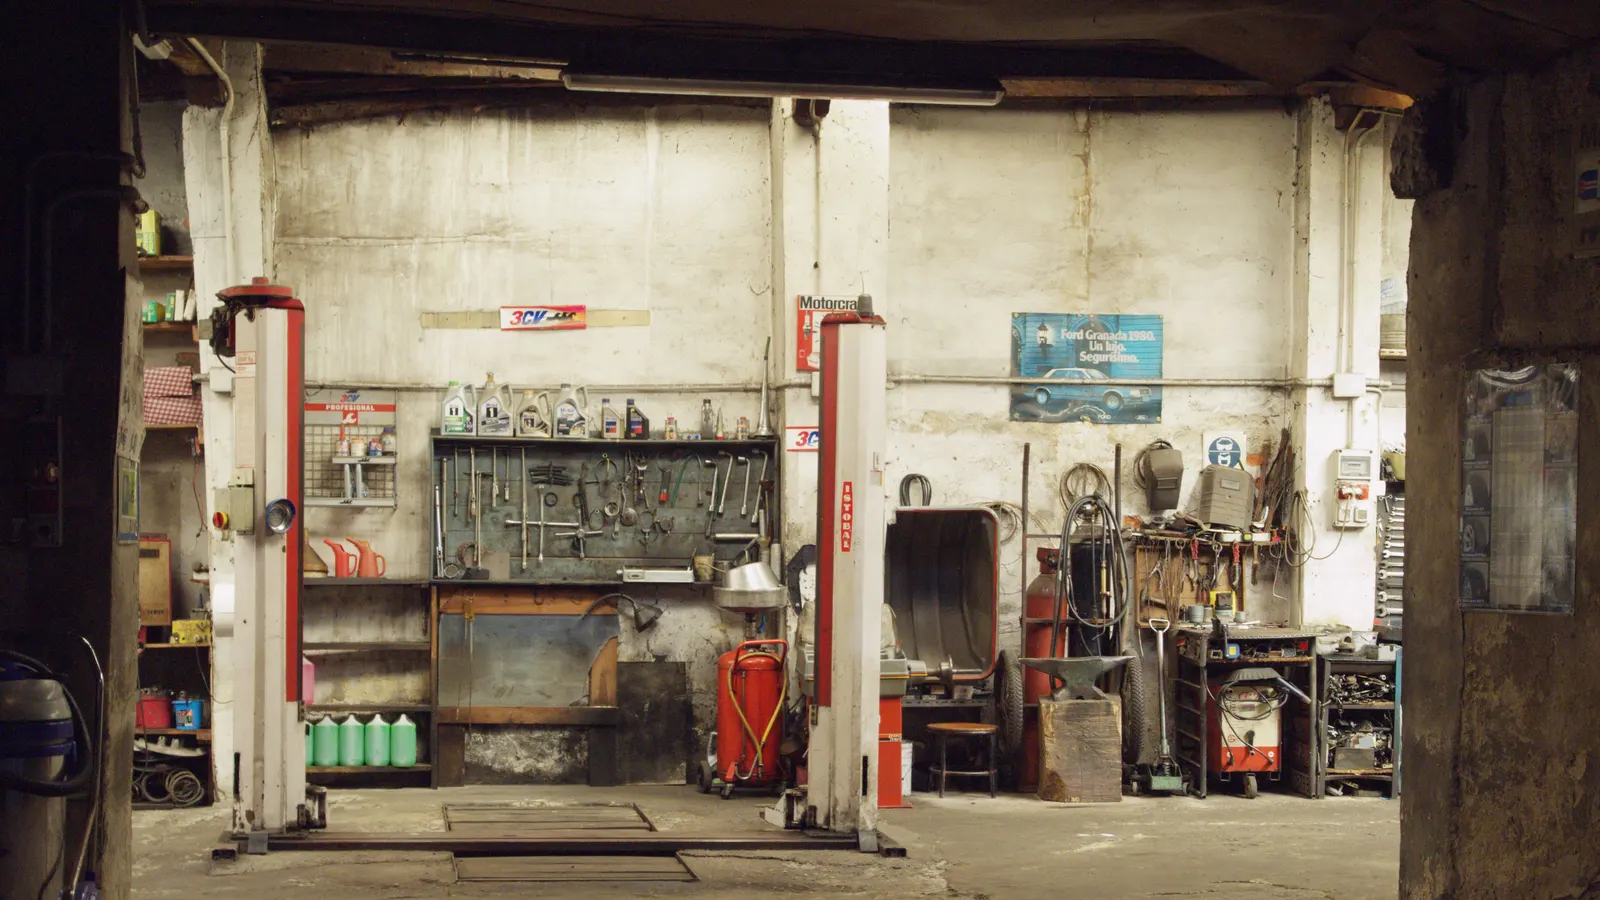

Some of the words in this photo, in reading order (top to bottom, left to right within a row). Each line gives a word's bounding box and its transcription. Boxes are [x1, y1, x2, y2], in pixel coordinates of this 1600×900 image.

[800, 296, 858, 310] Motorcra
[510, 310, 547, 326] 3CV
[1061, 328, 1084, 340] Ford
[1085, 329, 1127, 341] Granada
[1128, 330, 1156, 342] 1980.
[1089, 341, 1103, 351] Un
[1105, 340, 1126, 353] lujo.
[795, 431, 819, 447] 3C
[842, 484, 852, 549] ISTOBAL
